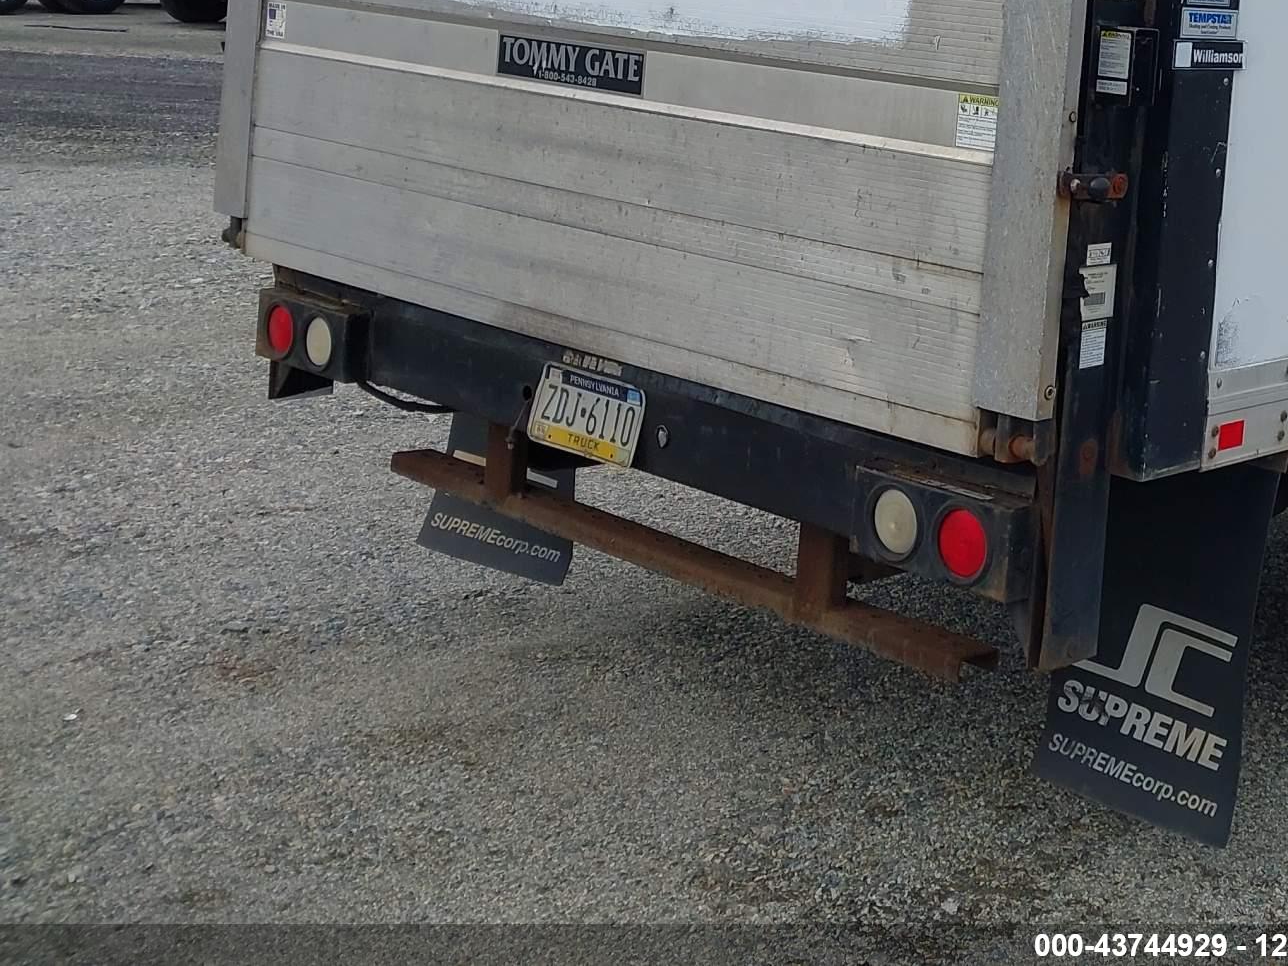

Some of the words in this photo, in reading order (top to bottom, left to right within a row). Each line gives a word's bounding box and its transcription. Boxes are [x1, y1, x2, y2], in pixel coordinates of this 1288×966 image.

[502, 36, 580, 72] TOMMY
[585, 48, 642, 82] GATE
[538, 70, 597, 87] 1-800-543-8428
[569, 374, 620, 398] PENNSYLVANIA
[567, 433, 600, 452] TRUCK
[430, 511, 561, 564] SUPREMEcorp.com
[1057, 679, 1228, 771] SUPREME
[1048, 733, 1219, 818] SUPREMEcorp.com
